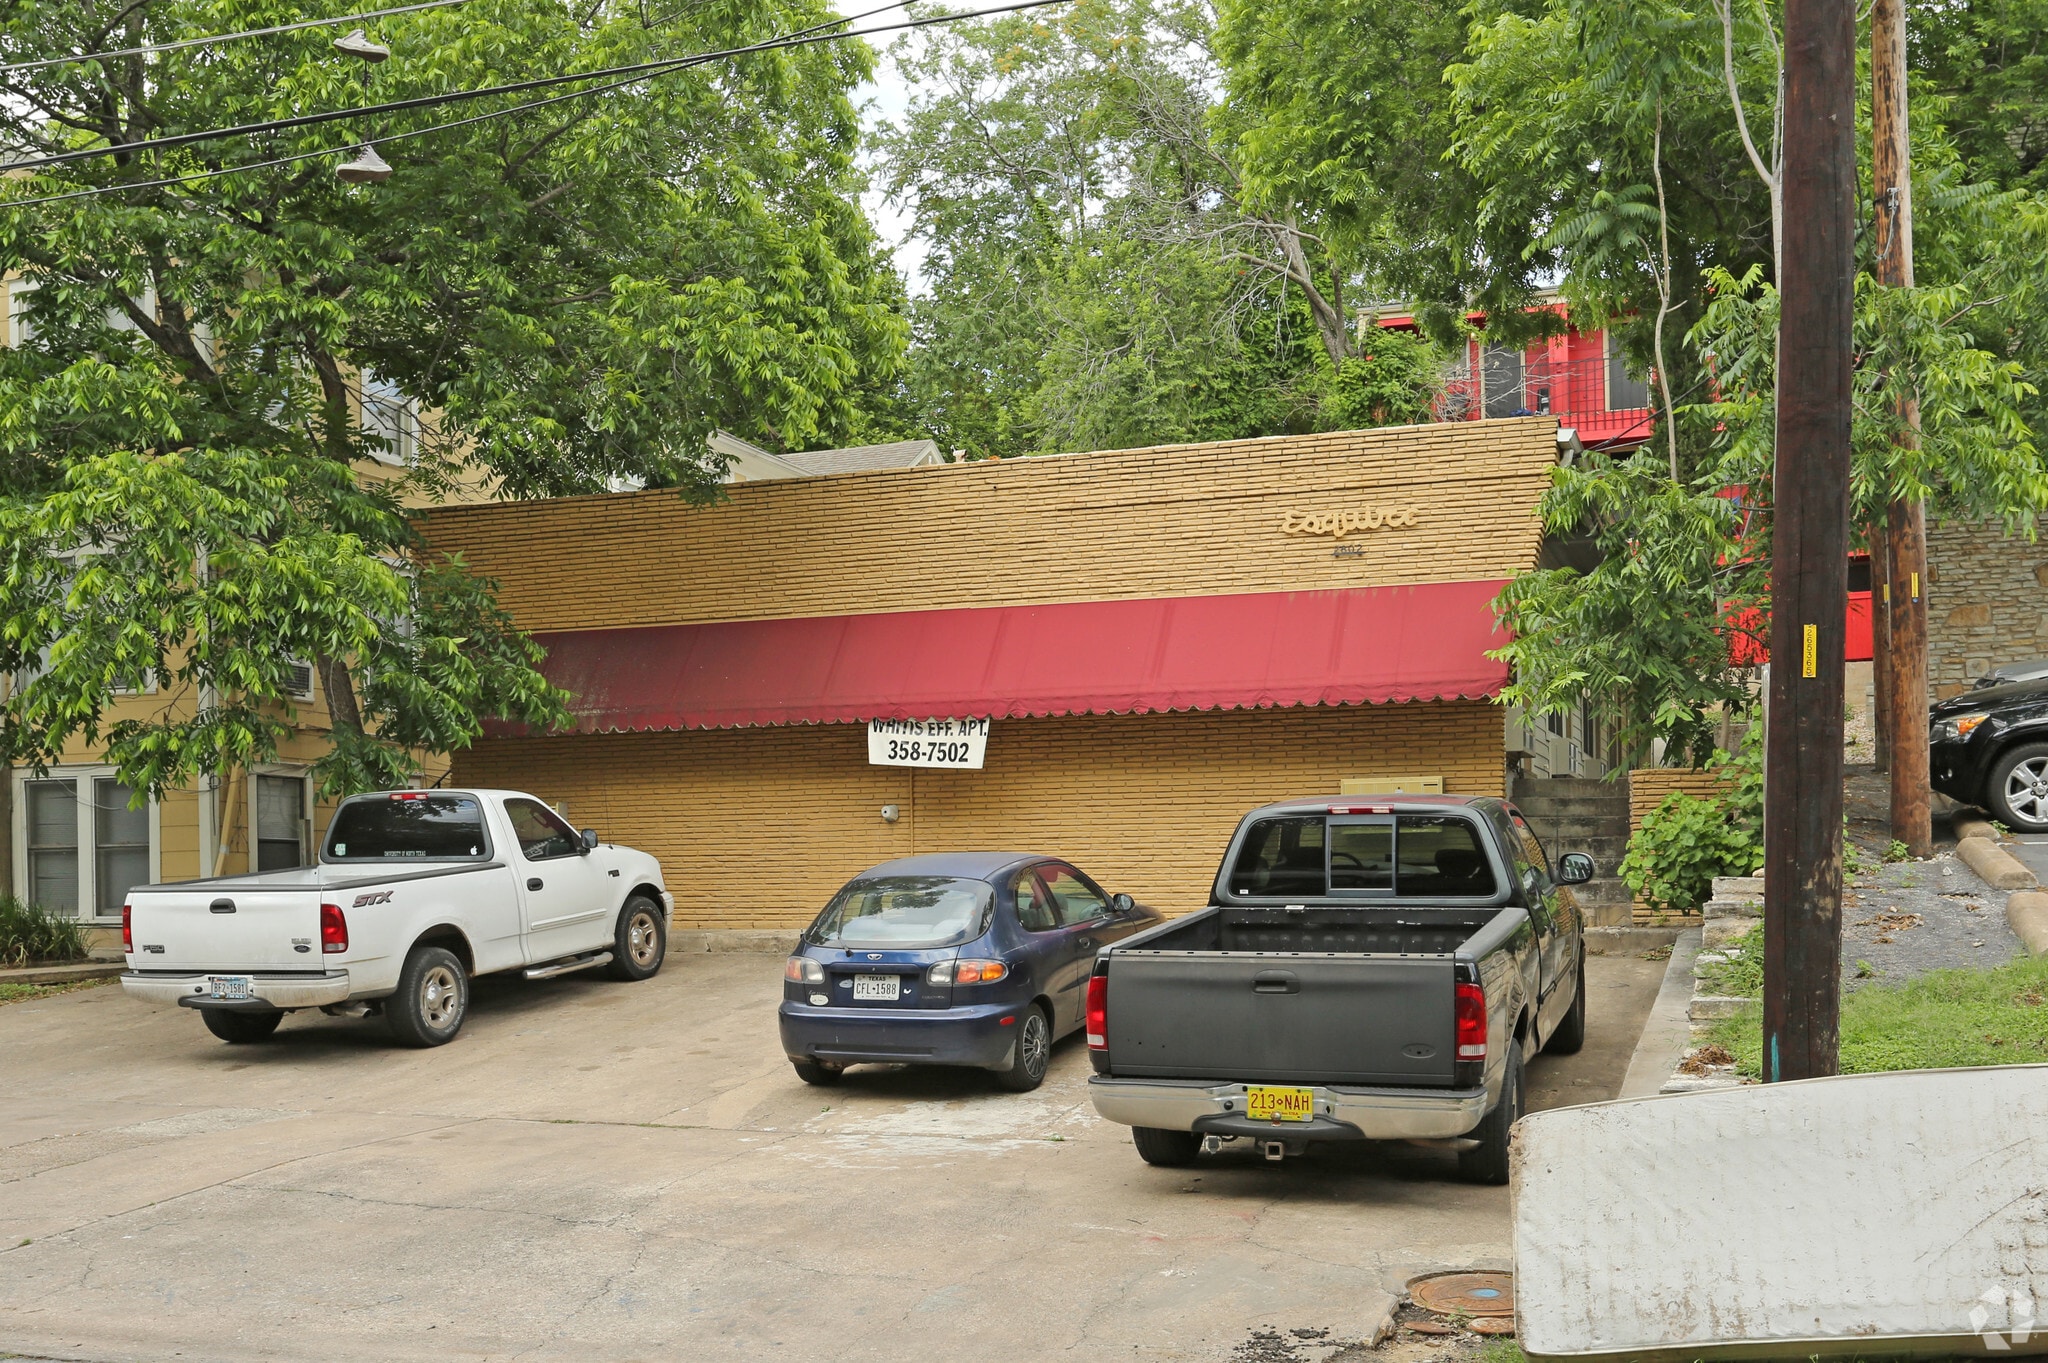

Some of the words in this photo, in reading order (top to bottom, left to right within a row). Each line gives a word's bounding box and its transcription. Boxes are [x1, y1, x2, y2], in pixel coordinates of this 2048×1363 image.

[1282, 505, 1419, 538] Esquire
[928, 721, 954, 737] EFF.
[958, 719, 987, 737] APT.
[888, 740, 969, 762] 358-7502
[352, 890, 394, 908] STX
